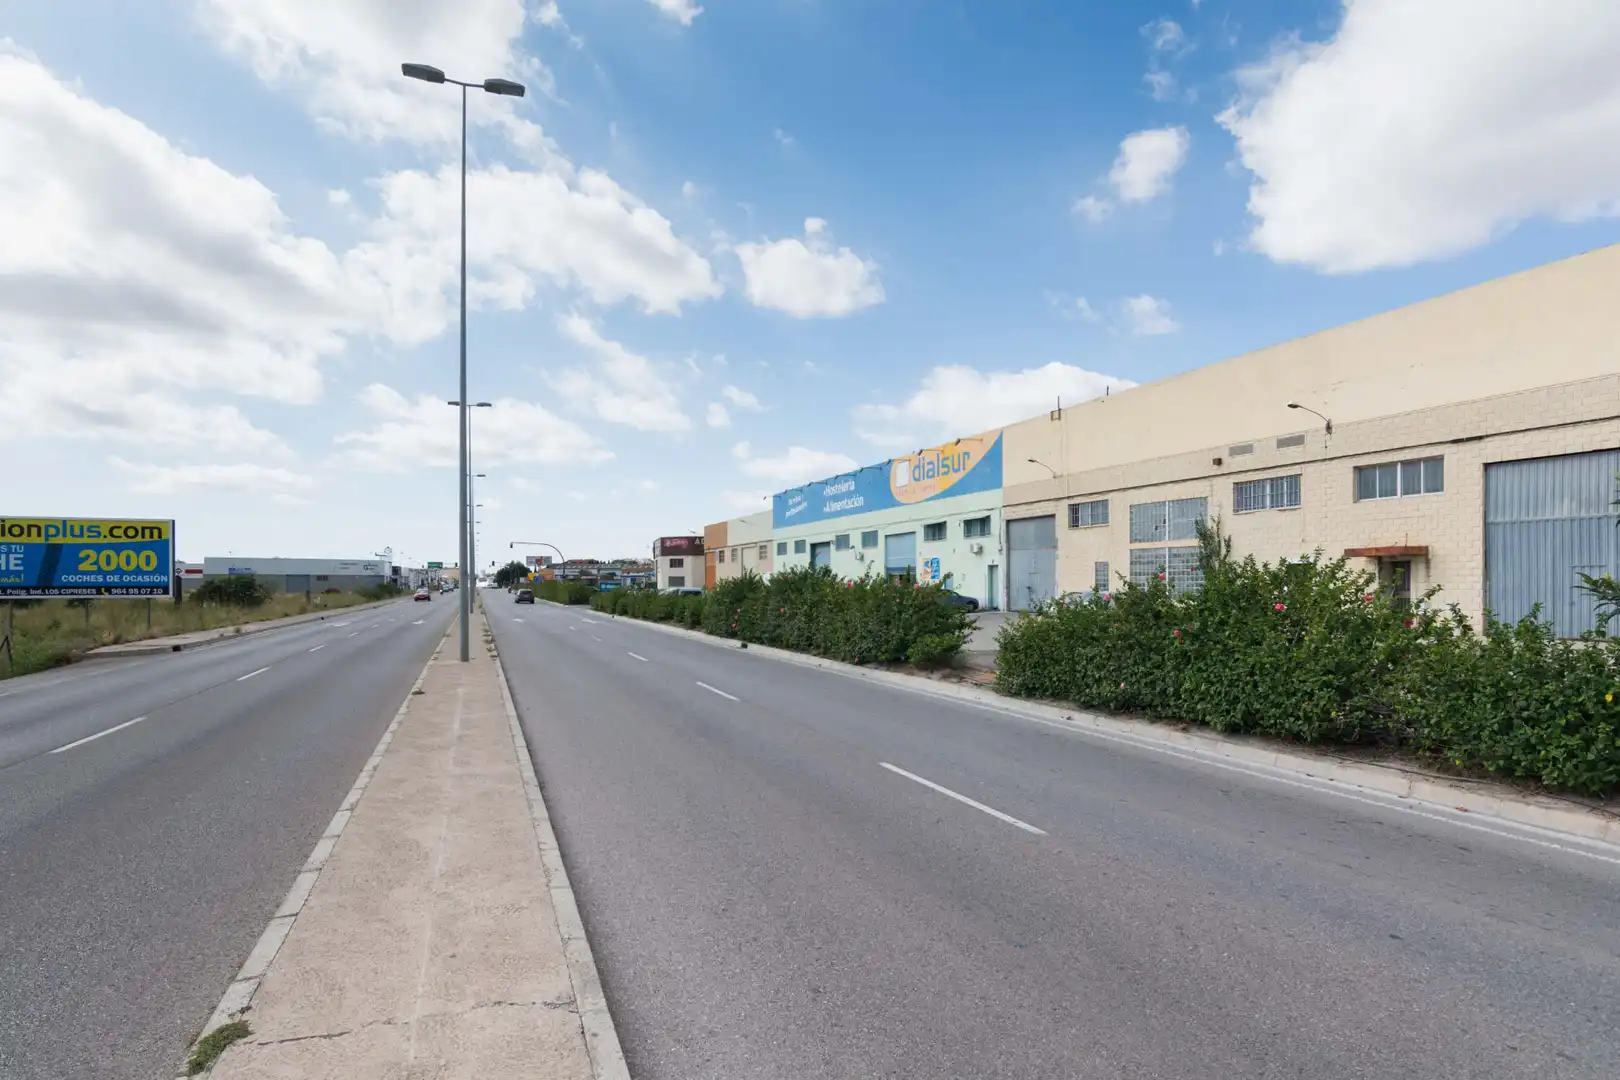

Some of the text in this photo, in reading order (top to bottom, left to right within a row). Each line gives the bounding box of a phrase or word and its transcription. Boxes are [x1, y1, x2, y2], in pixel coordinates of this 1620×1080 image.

[912, 452, 971, 482] dialsur
[11, 545, 24, 553] TU
[78, 549, 158, 571] 2000
[61, 574, 104, 582] COCHES
[122, 573, 168, 582] OCASIÓN
